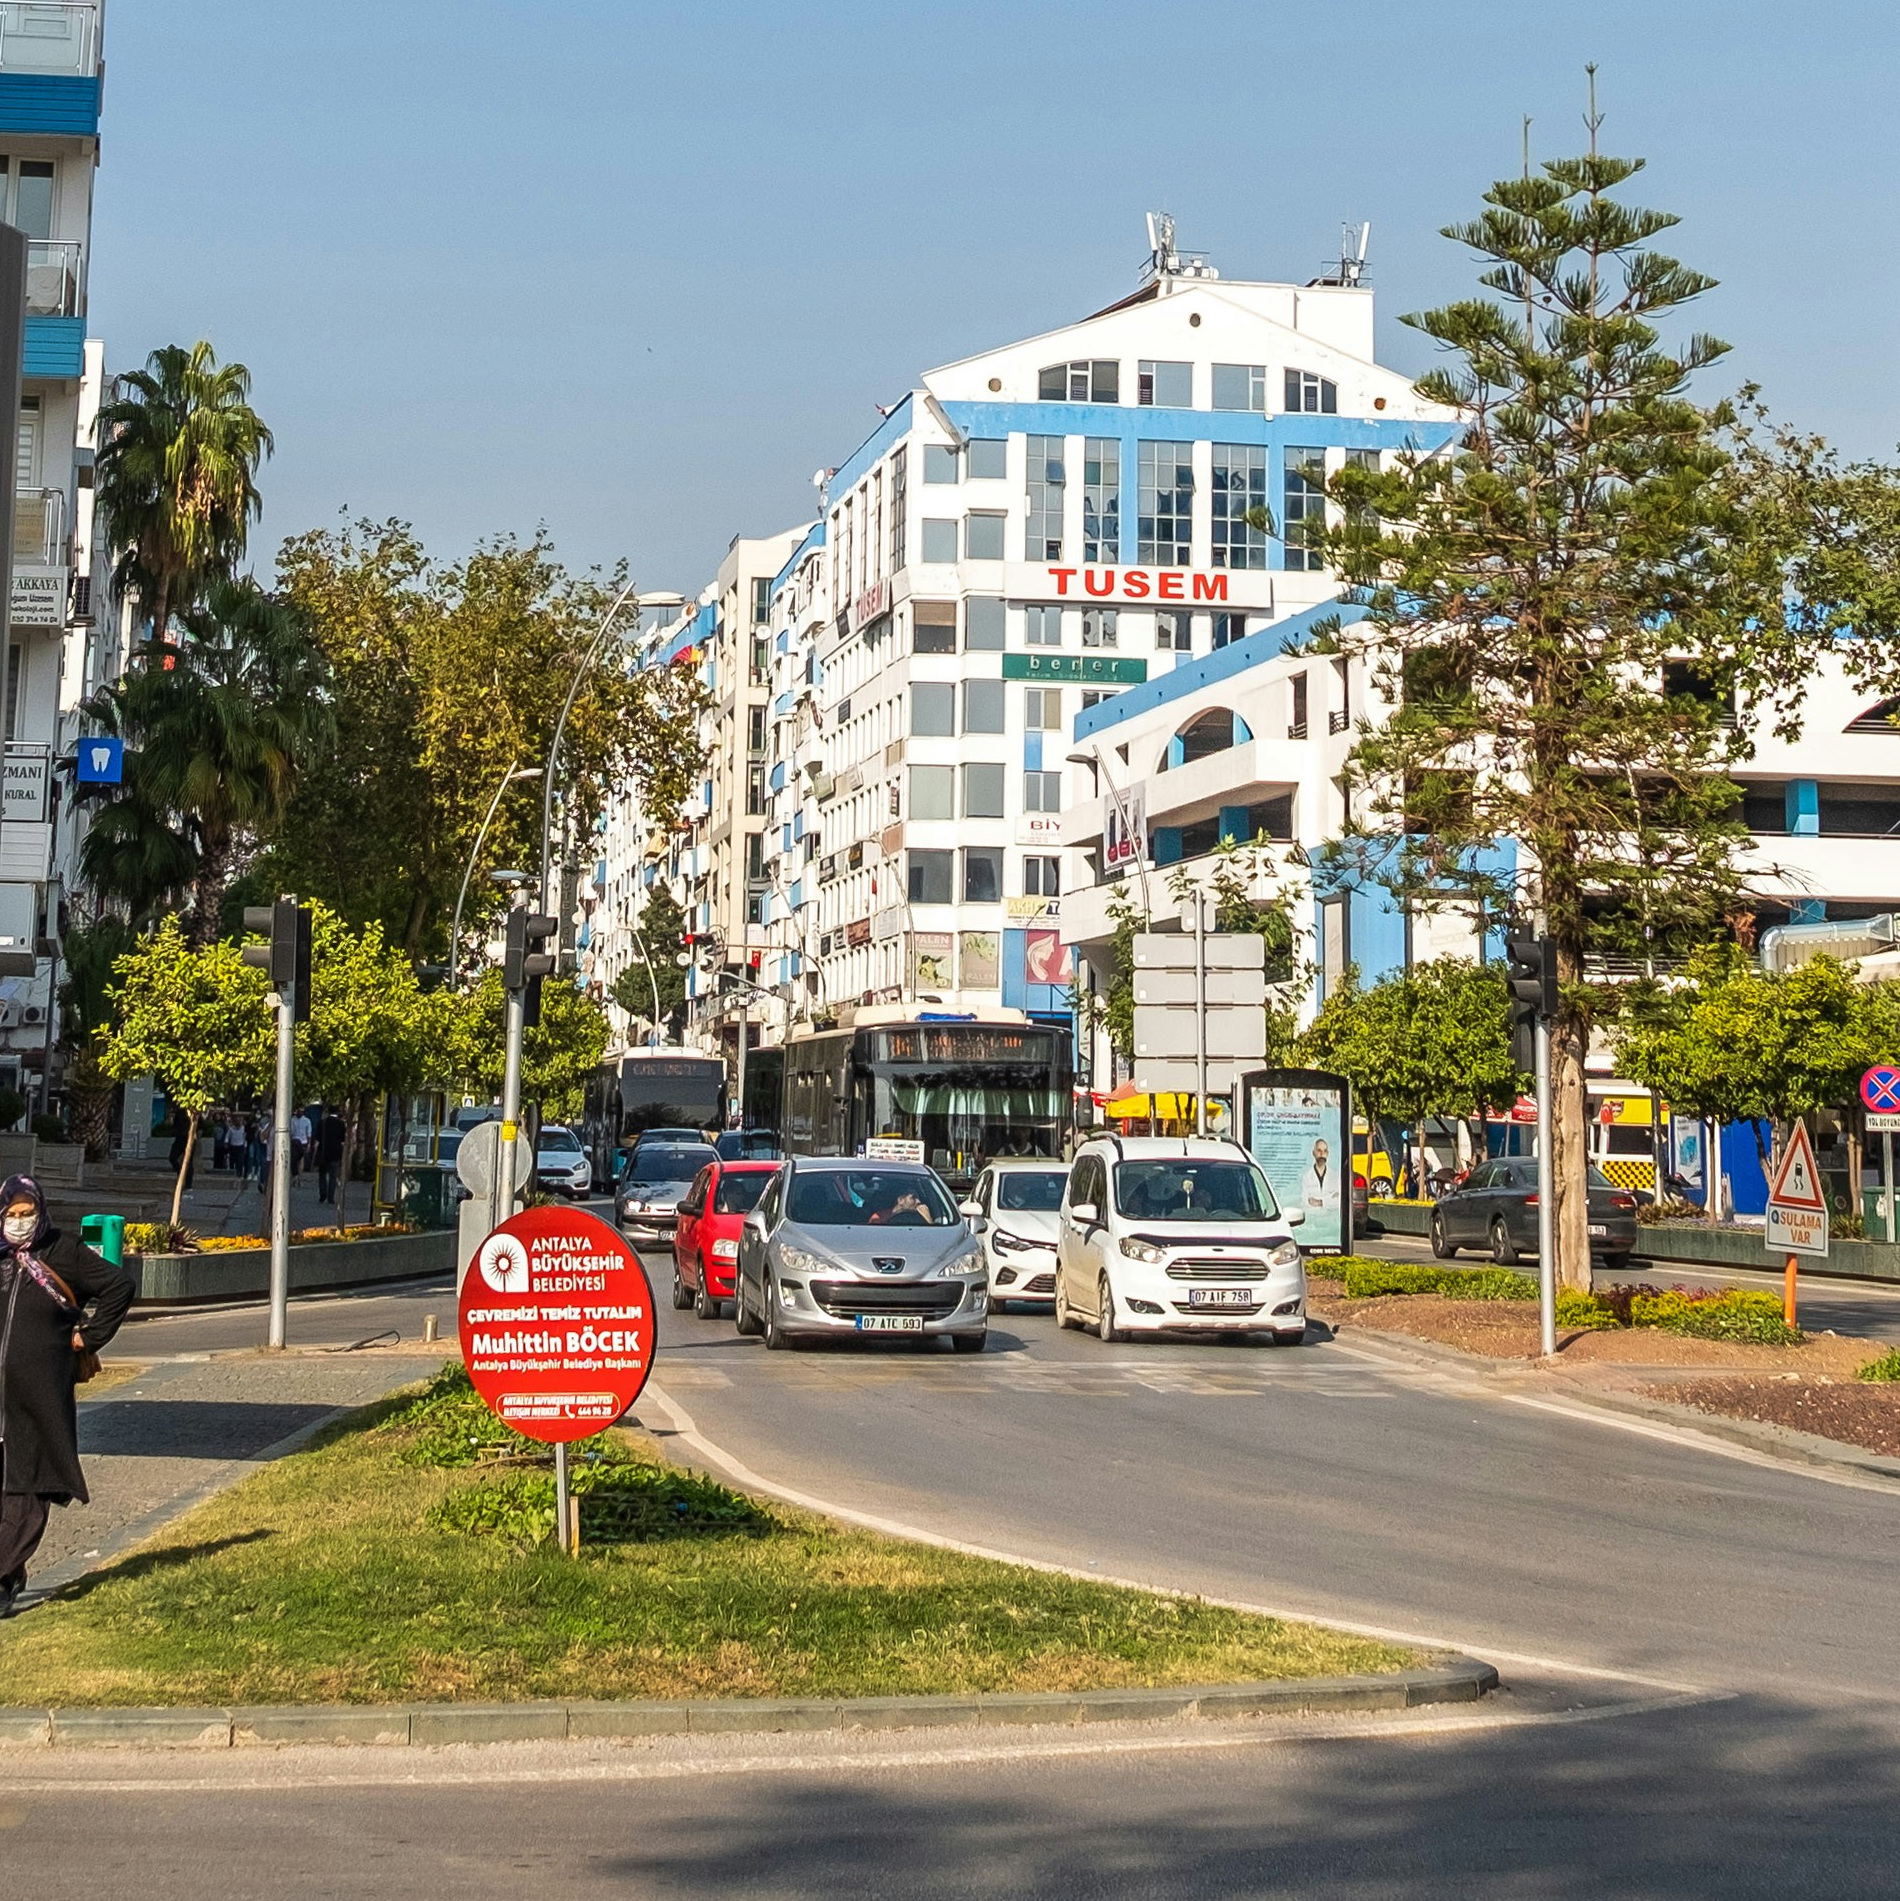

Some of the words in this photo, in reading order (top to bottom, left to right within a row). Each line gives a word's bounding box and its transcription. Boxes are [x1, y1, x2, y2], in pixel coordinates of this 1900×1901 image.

[15, 578, 59, 591] AKKAYA
[1047, 567, 1229, 602] TUSEM
[855, 582, 885, 623] TUSEM
[1868, 1117, 1878, 1127] YOL
[1780, 1211, 1822, 1229] SULAMA
[531, 1236, 593, 1252] ANTALYA
[1790, 1229, 1811, 1245] VAR
[531, 1250, 625, 1274] BÜYÜKŞEHİR
[532, 1273, 606, 1293] BELEDİYESİ
[1195, 1291, 1206, 1302] 07
[1210, 1291, 1226, 1302] AIF
[467, 1305, 538, 1325] ÇEVREMİZİ
[540, 1304, 581, 1321] TEMİZ
[583, 1306, 643, 1319] TUTALIM
[863, 1317, 876, 1329] 07
[472, 1331, 562, 1355] Muhittin
[566, 1325, 640, 1353] BÖCEK
[472, 1359, 508, 1373] Antalya
[510, 1358, 561, 1373] Büyükşehir
[563, 1357, 603, 1372] Belediye
[605, 1357, 642, 1371] Başkanı
[503, 1395, 534, 1405] ANTALYA
